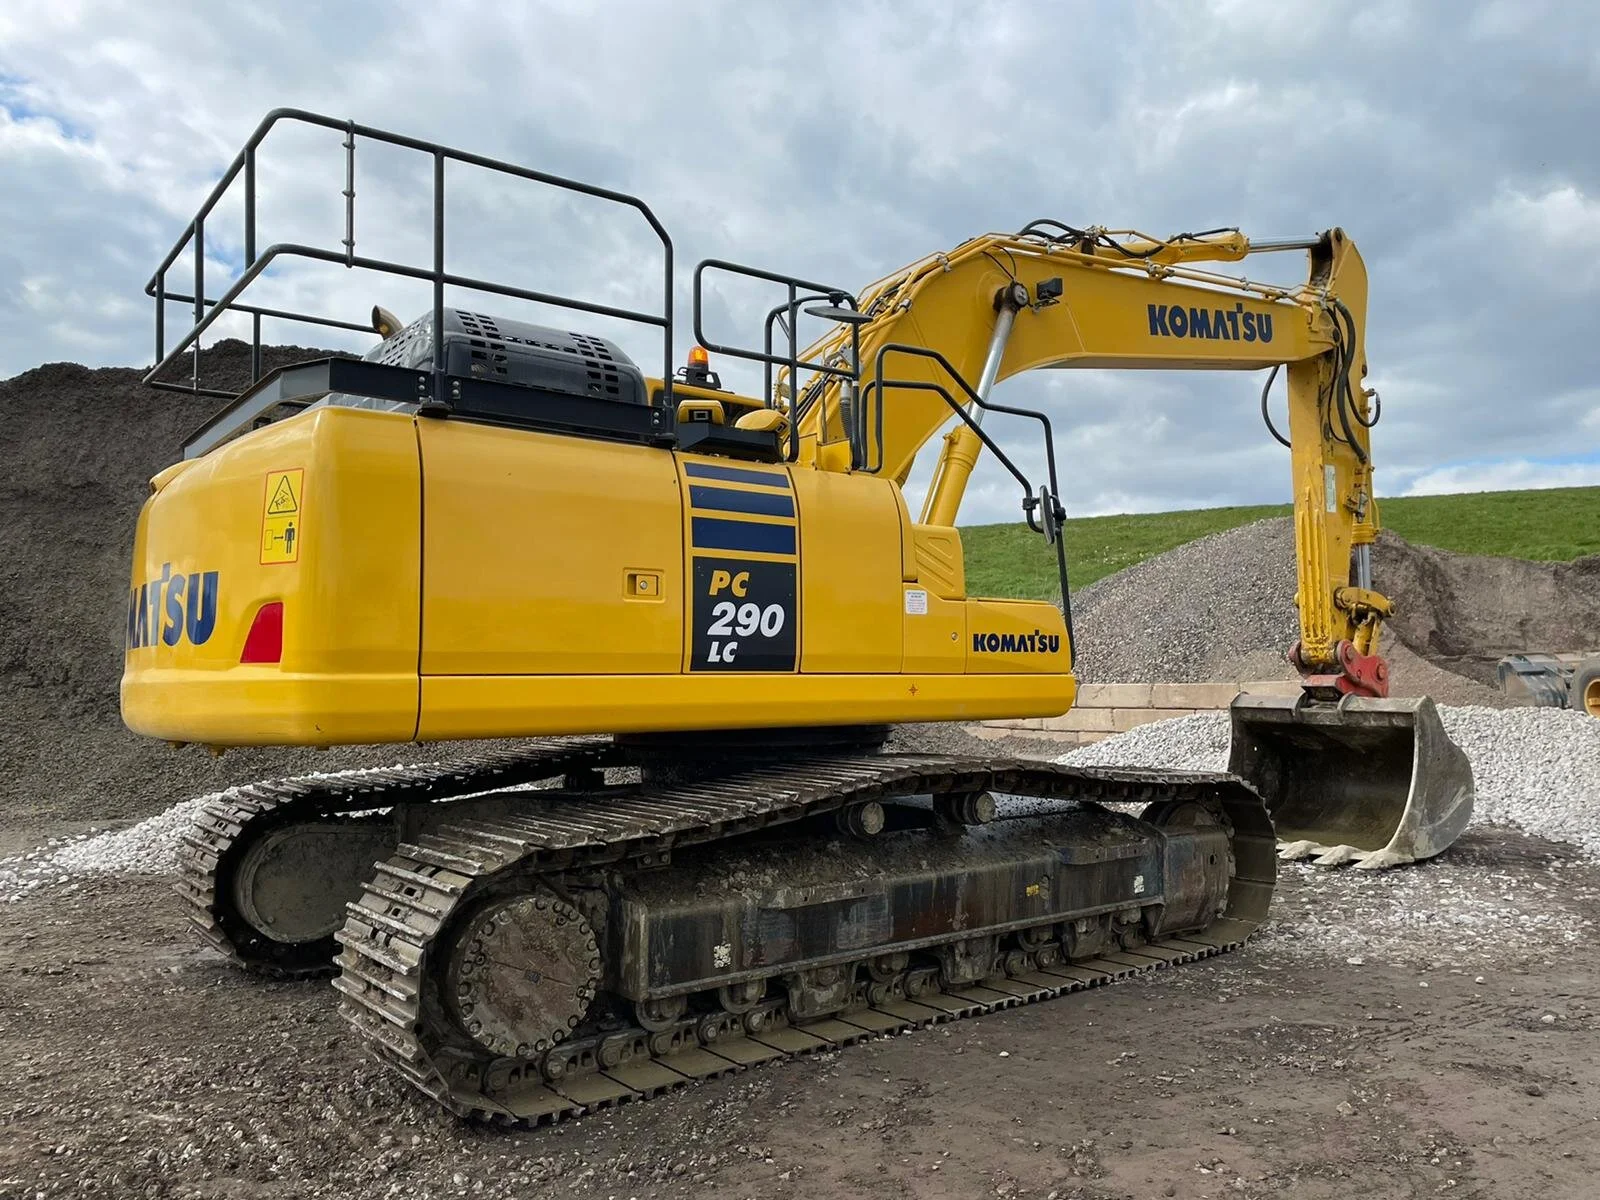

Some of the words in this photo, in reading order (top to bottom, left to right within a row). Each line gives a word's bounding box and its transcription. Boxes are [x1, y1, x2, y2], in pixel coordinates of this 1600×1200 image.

[1147, 302, 1273, 344] KOMATSU
[708, 569, 750, 597] PC
[706, 601, 785, 638] 290
[706, 641, 738, 663] LC
[973, 629, 1060, 653] KOMATSU
